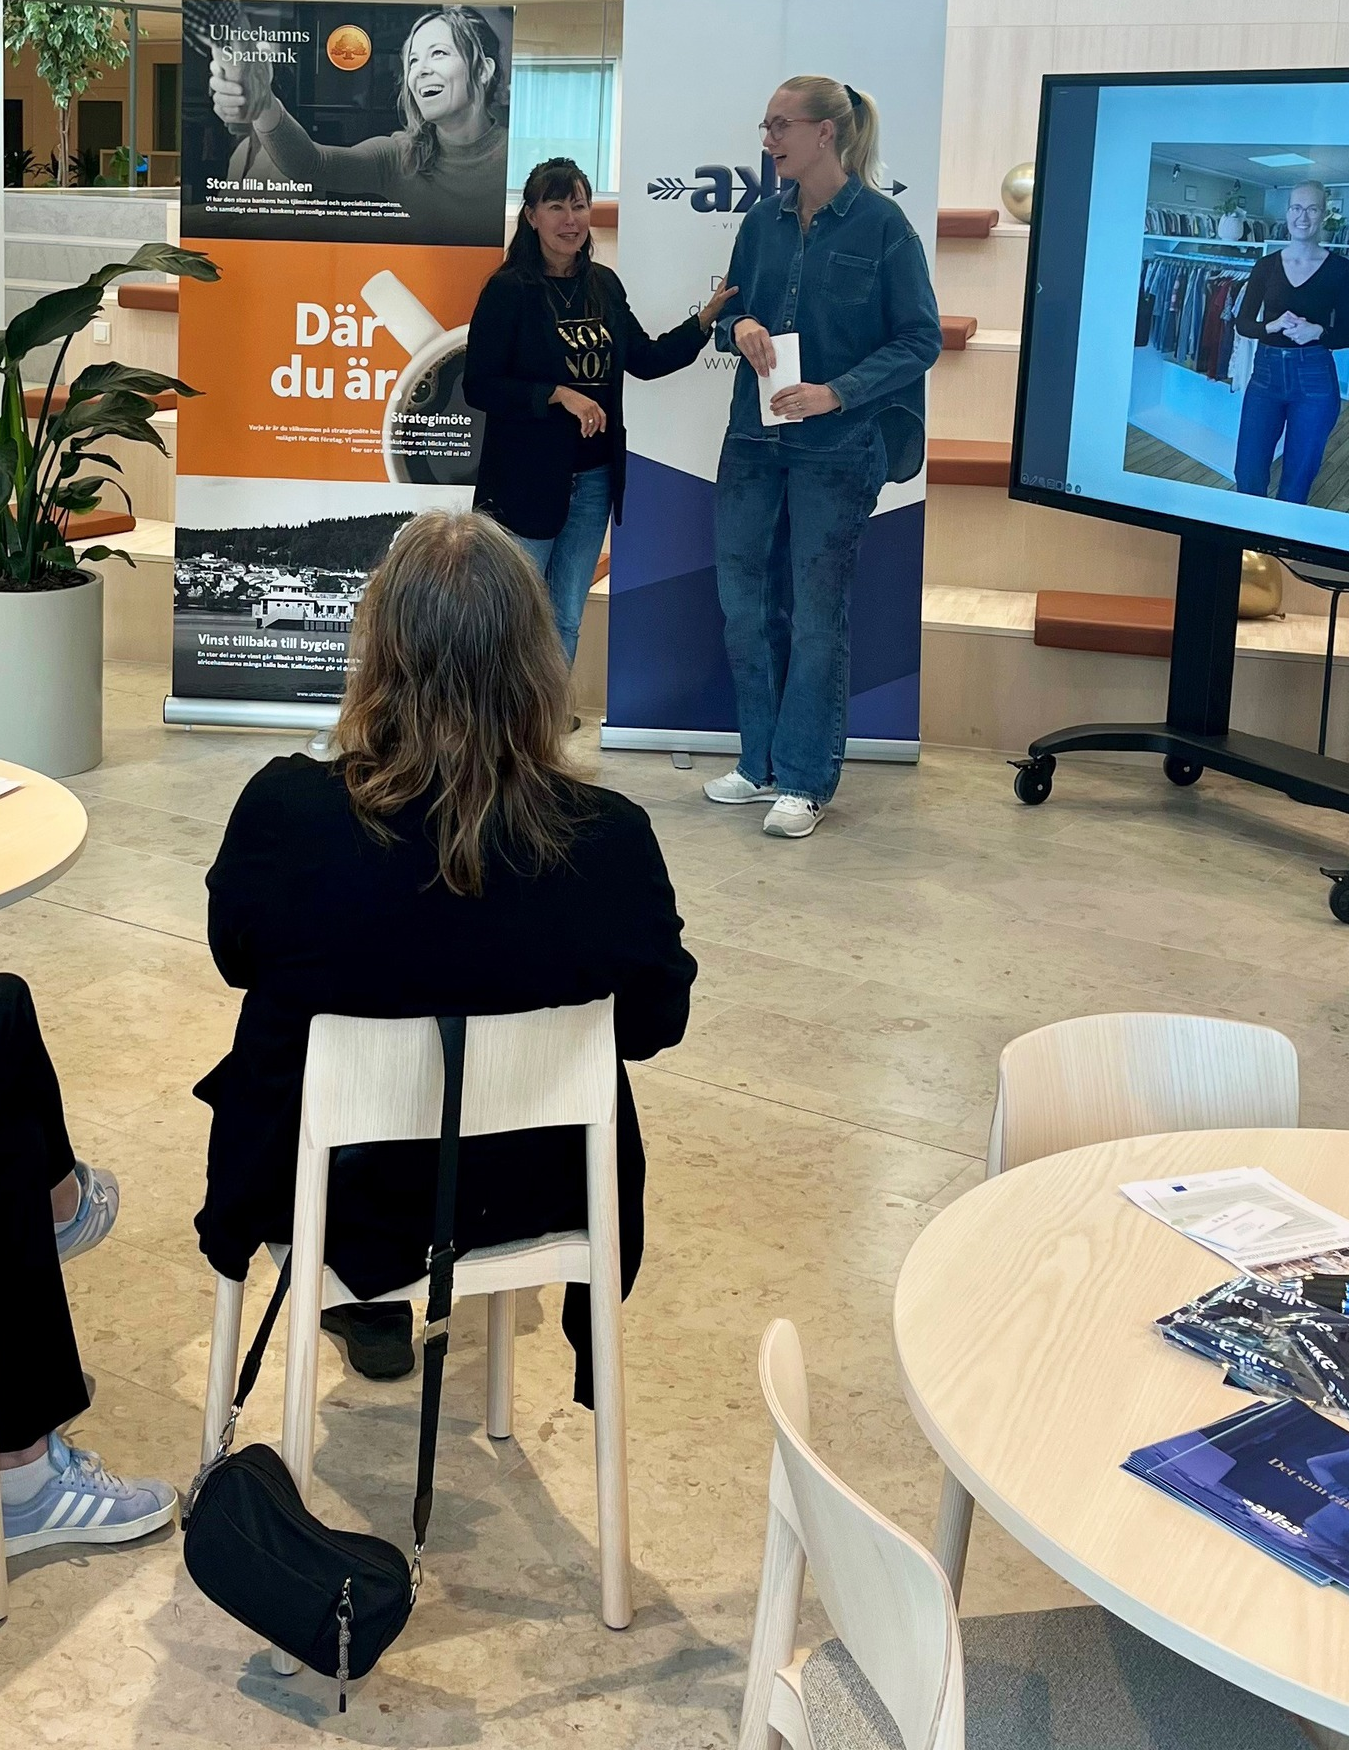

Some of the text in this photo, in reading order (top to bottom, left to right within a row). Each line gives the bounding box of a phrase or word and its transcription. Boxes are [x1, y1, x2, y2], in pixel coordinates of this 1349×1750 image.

[209, 24, 310, 43] Ulricehamns
[221, 46, 298, 66] Sparbank
[206, 177, 312, 192] Stora lilla banken
[296, 302, 384, 347] Där
[270, 354, 402, 401] du är.
[391, 412, 472, 427] Strategimöte
[198, 633, 344, 652] Vinst tillbaka till bygden
[1268, 1458, 1297, 1476] Det
[1295, 1475, 1328, 1496] som
